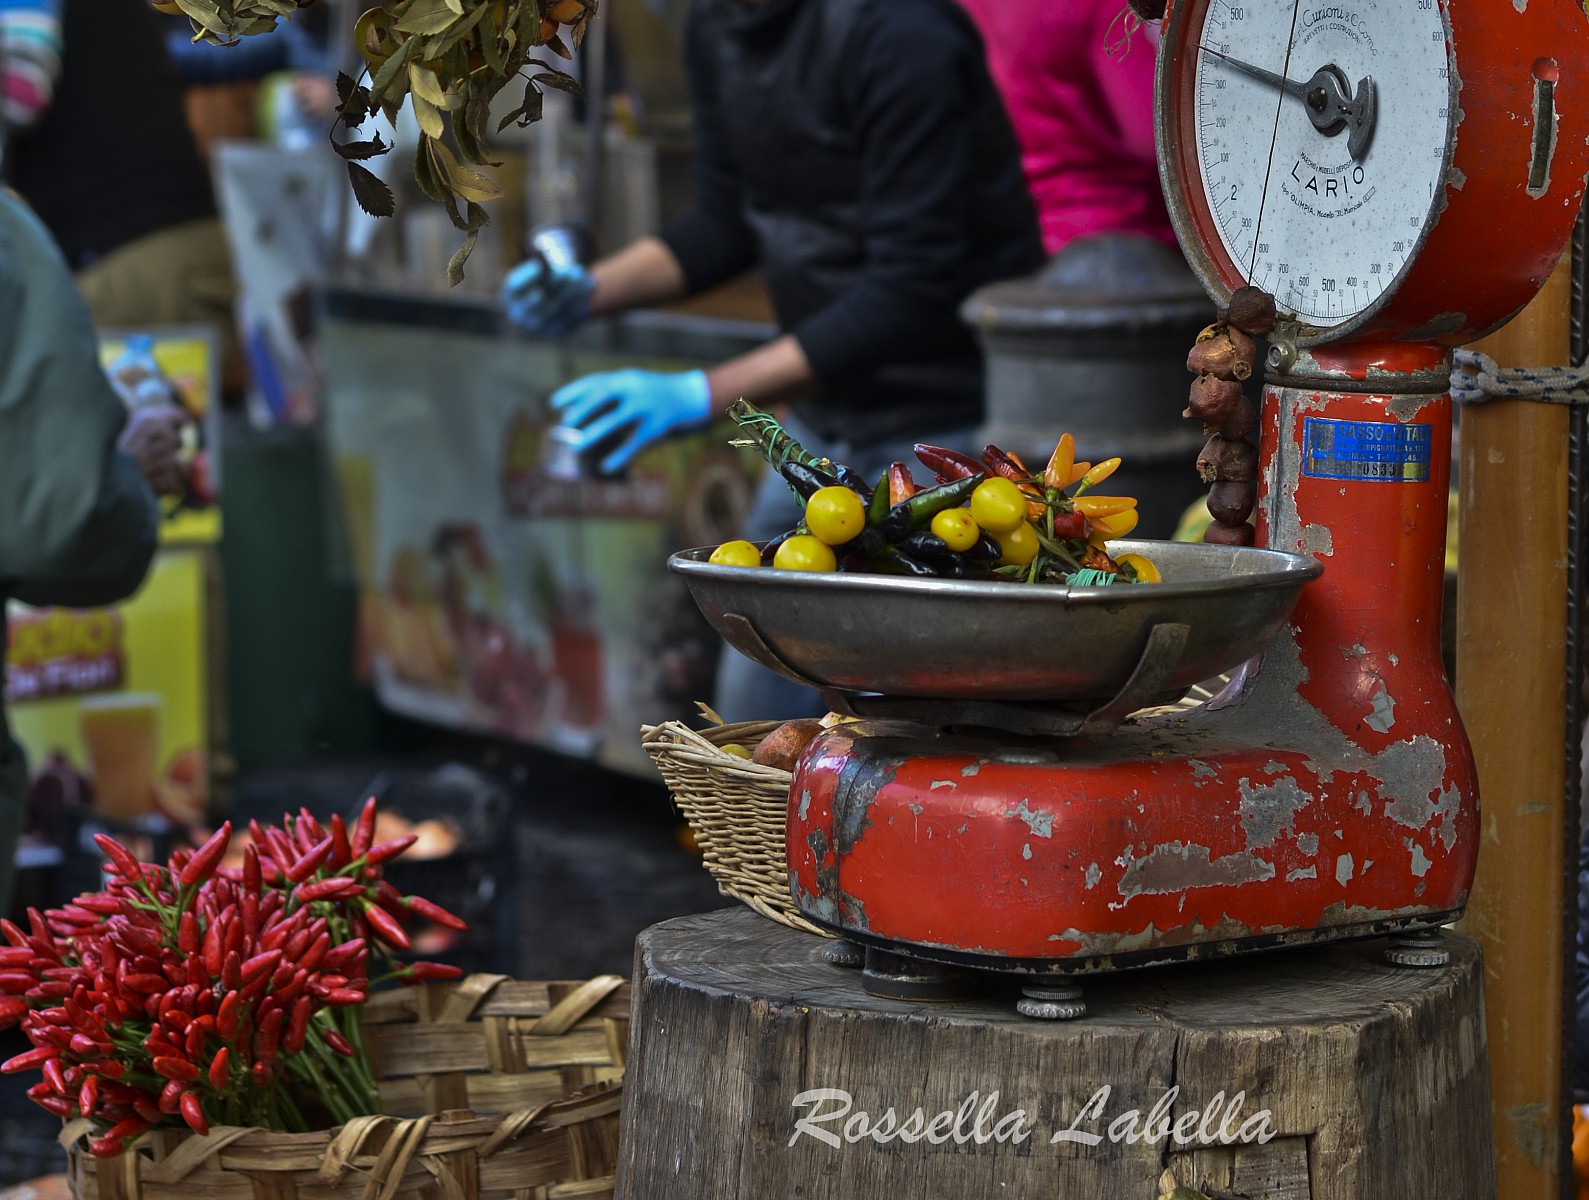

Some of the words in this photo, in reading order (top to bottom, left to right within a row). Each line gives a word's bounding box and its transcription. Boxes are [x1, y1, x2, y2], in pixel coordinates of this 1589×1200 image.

[1230, 8, 1244, 21] 500
[1432, 32, 1443, 42] 600
[1216, 118, 1226, 128] 200
[1220, 152, 1230, 162] 100
[1291, 160, 1364, 198] LARIO
[1230, 184, 1238, 201] 2
[1428, 182, 1432, 198] 1
[1241, 218, 1252, 228] 900
[1410, 216, 1420, 226] 100
[1392, 242, 1404, 252] 200
[1278, 264, 1288, 274] 700
[1370, 264, 1382, 274] 300
[1298, 276, 1310, 287] 600
[1322, 279, 1336, 292] 500
[1346, 276, 1358, 287] 400
[1338, 424, 1384, 441] SASSO
